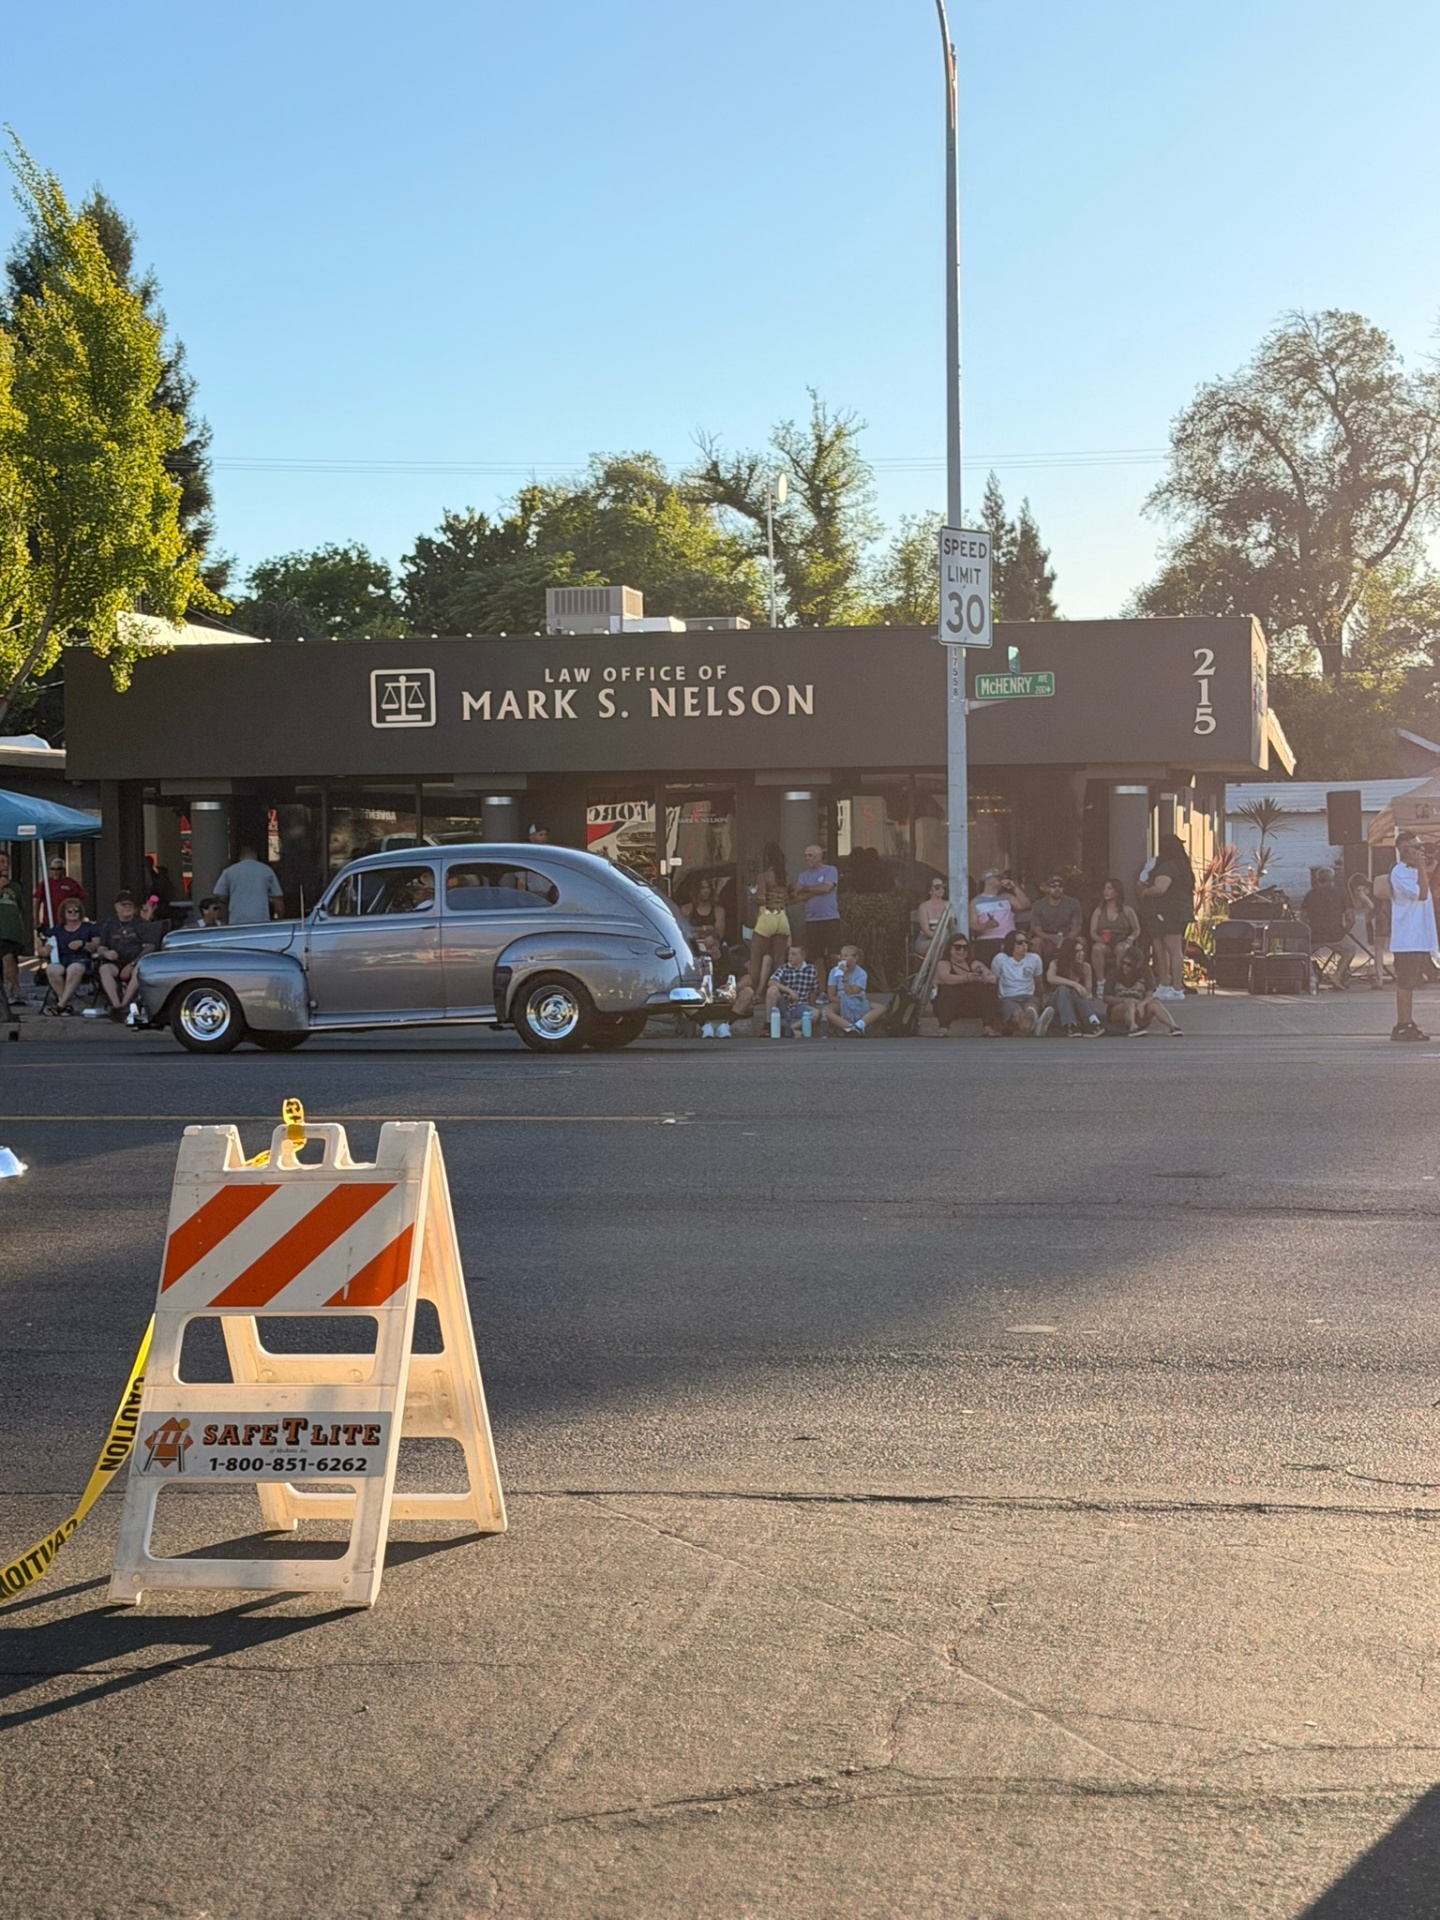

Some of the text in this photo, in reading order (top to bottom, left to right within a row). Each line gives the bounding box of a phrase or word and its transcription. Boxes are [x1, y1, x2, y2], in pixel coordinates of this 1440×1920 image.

[943, 538, 987, 559] SPEED
[947, 565, 982, 585] LIMIT
[946, 591, 985, 635] 30
[544, 665, 727, 683] LAW OFFICE OF
[981, 674, 1048, 696] McHENRY AVE
[461, 684, 814, 720] MARK S. NELSON
[1192, 647, 1217, 735] 215
[98, 1376, 145, 1472] CAUTION
[209, 1457, 368, 1472] 1-800-851-6262
